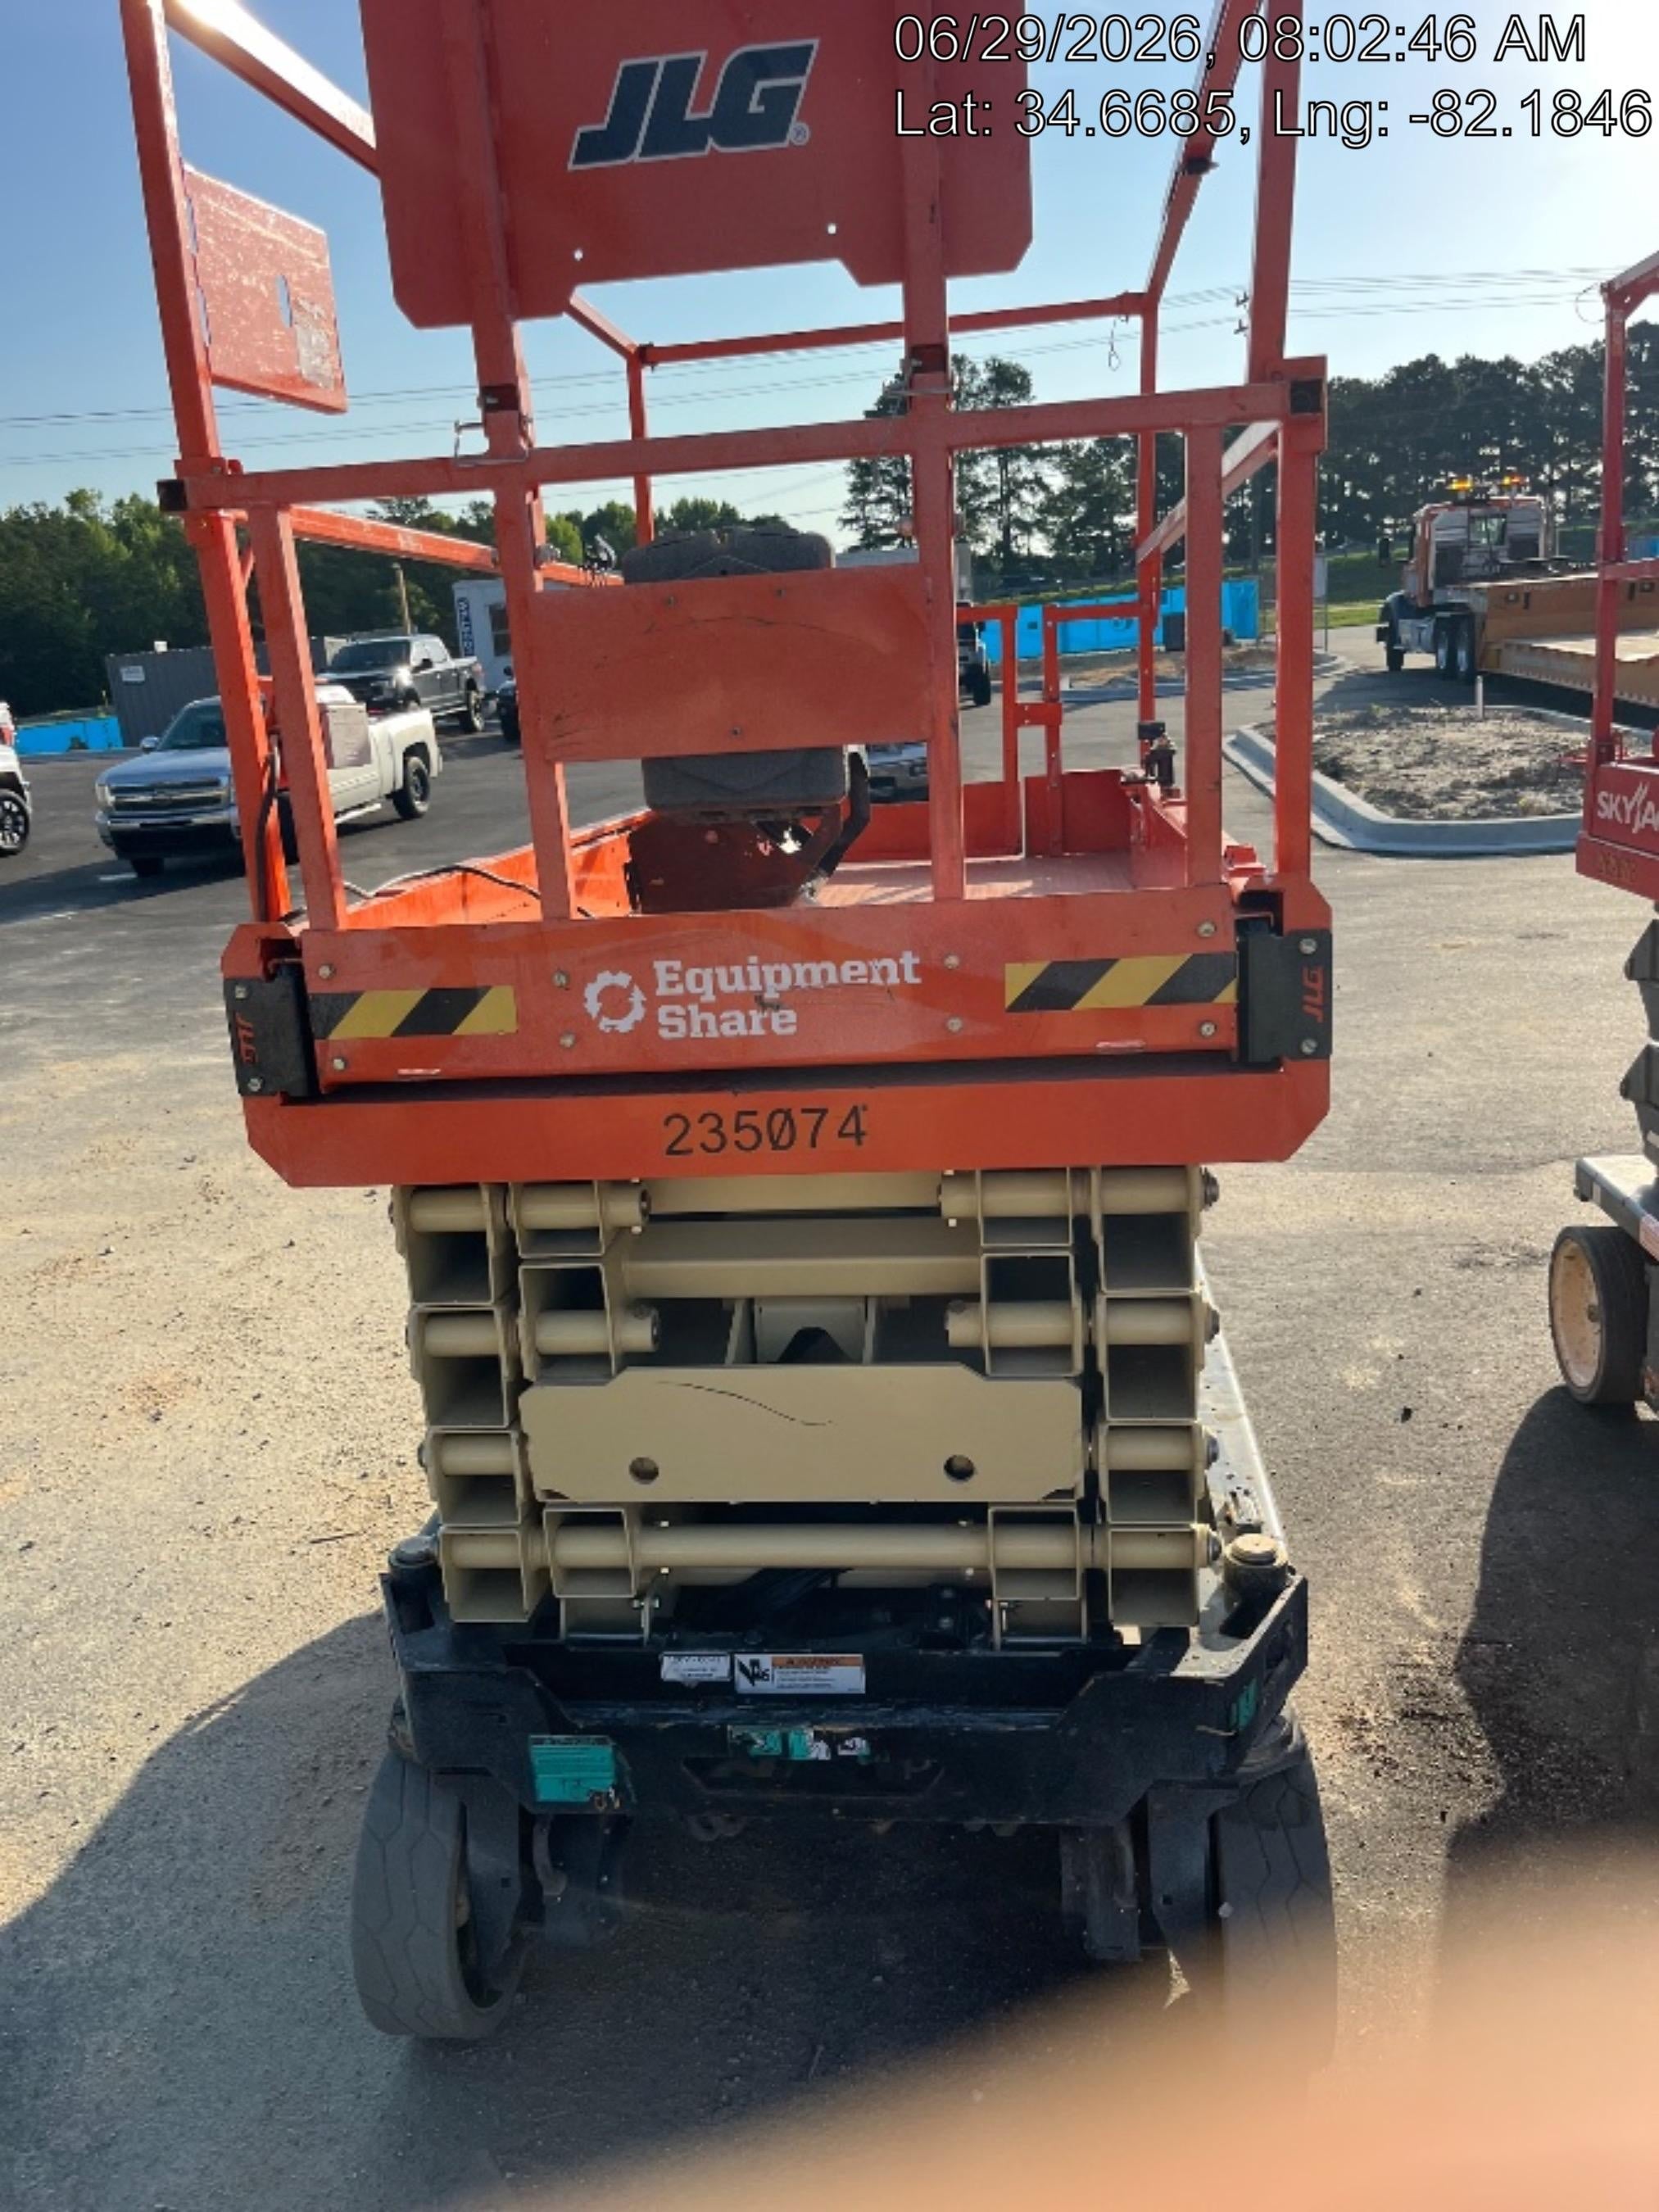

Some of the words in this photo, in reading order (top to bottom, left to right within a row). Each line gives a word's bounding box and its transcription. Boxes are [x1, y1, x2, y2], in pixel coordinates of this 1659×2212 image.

[568, 38, 819, 171] JLG
[652, 950, 923, 1003] Equipment
[1301, 965, 1324, 1024] JLG
[657, 1003, 798, 1040] Share
[663, 1103, 868, 1157] 235074
